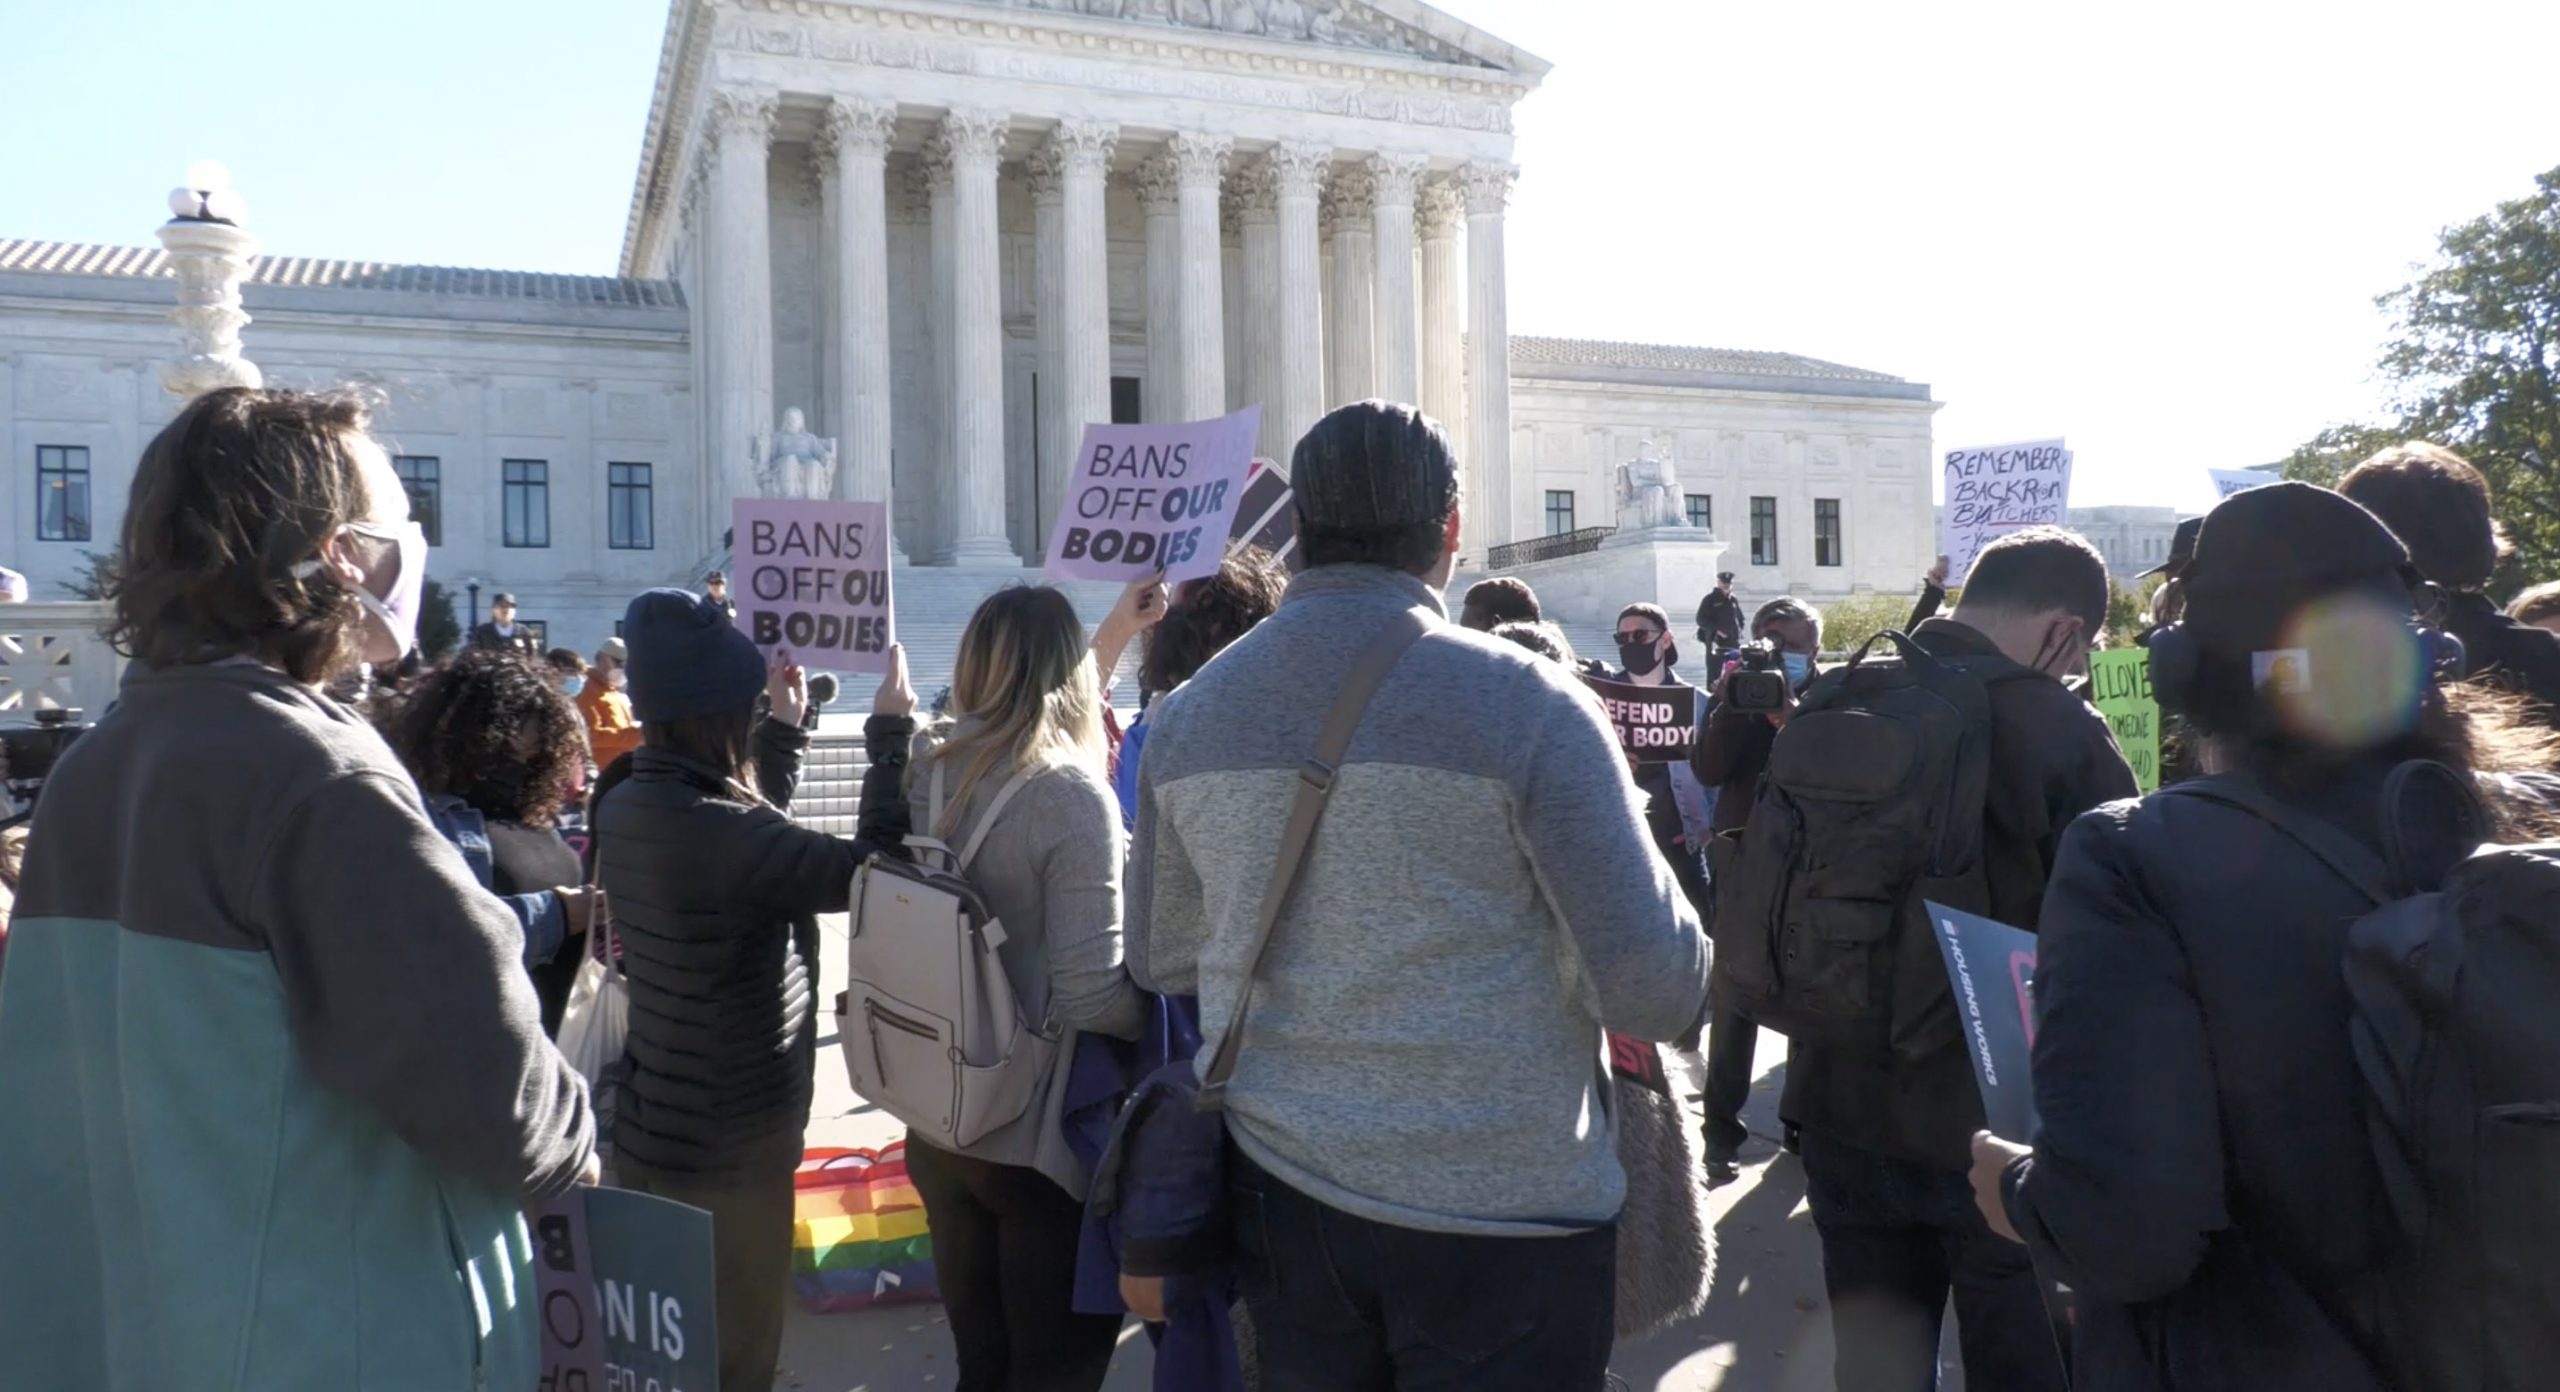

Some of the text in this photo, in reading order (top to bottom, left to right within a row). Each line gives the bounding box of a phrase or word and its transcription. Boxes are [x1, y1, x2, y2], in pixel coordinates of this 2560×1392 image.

[1089, 443, 1191, 478] BANS
[1078, 478, 1229, 522] OFF OUR
[752, 520, 863, 559] BANS
[1061, 526, 1202, 567] BODIES
[752, 565, 889, 607] OFF OU
[753, 611, 886, 653] BODIES
[2093, 661, 2153, 702] I LOVE
[1605, 698, 1673, 723] EFEND
[2106, 712, 2149, 739] OMEONE
[1633, 725, 1694, 747] BODY
[1948, 937, 1998, 1086] HOUSING WORKS
[649, 1291, 684, 1361] IS
